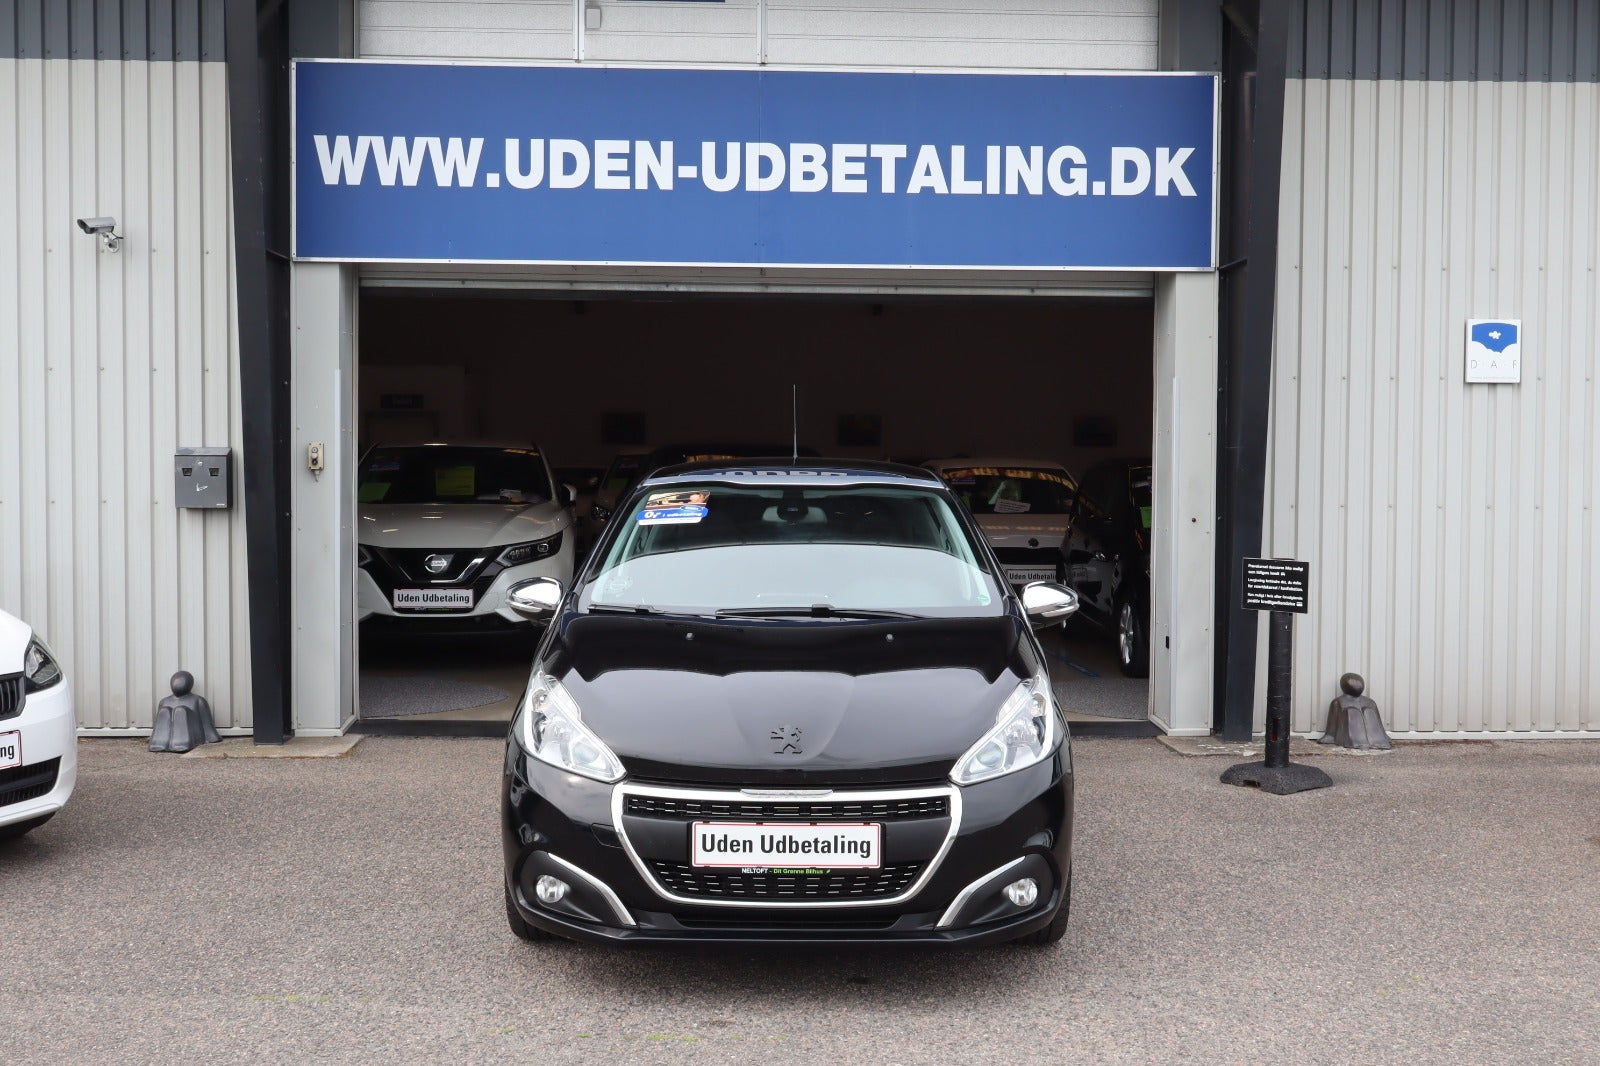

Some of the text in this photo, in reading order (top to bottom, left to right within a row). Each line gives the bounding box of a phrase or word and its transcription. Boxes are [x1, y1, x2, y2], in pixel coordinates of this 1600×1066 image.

[313, 133, 1197, 197] WWW.UDEN-UDBETALING.DK
[1028, 573, 1056, 581] Udbetali
[397, 593, 470, 604] Uden Udbetaling
[702, 833, 871, 860] Uden Udbetaling
